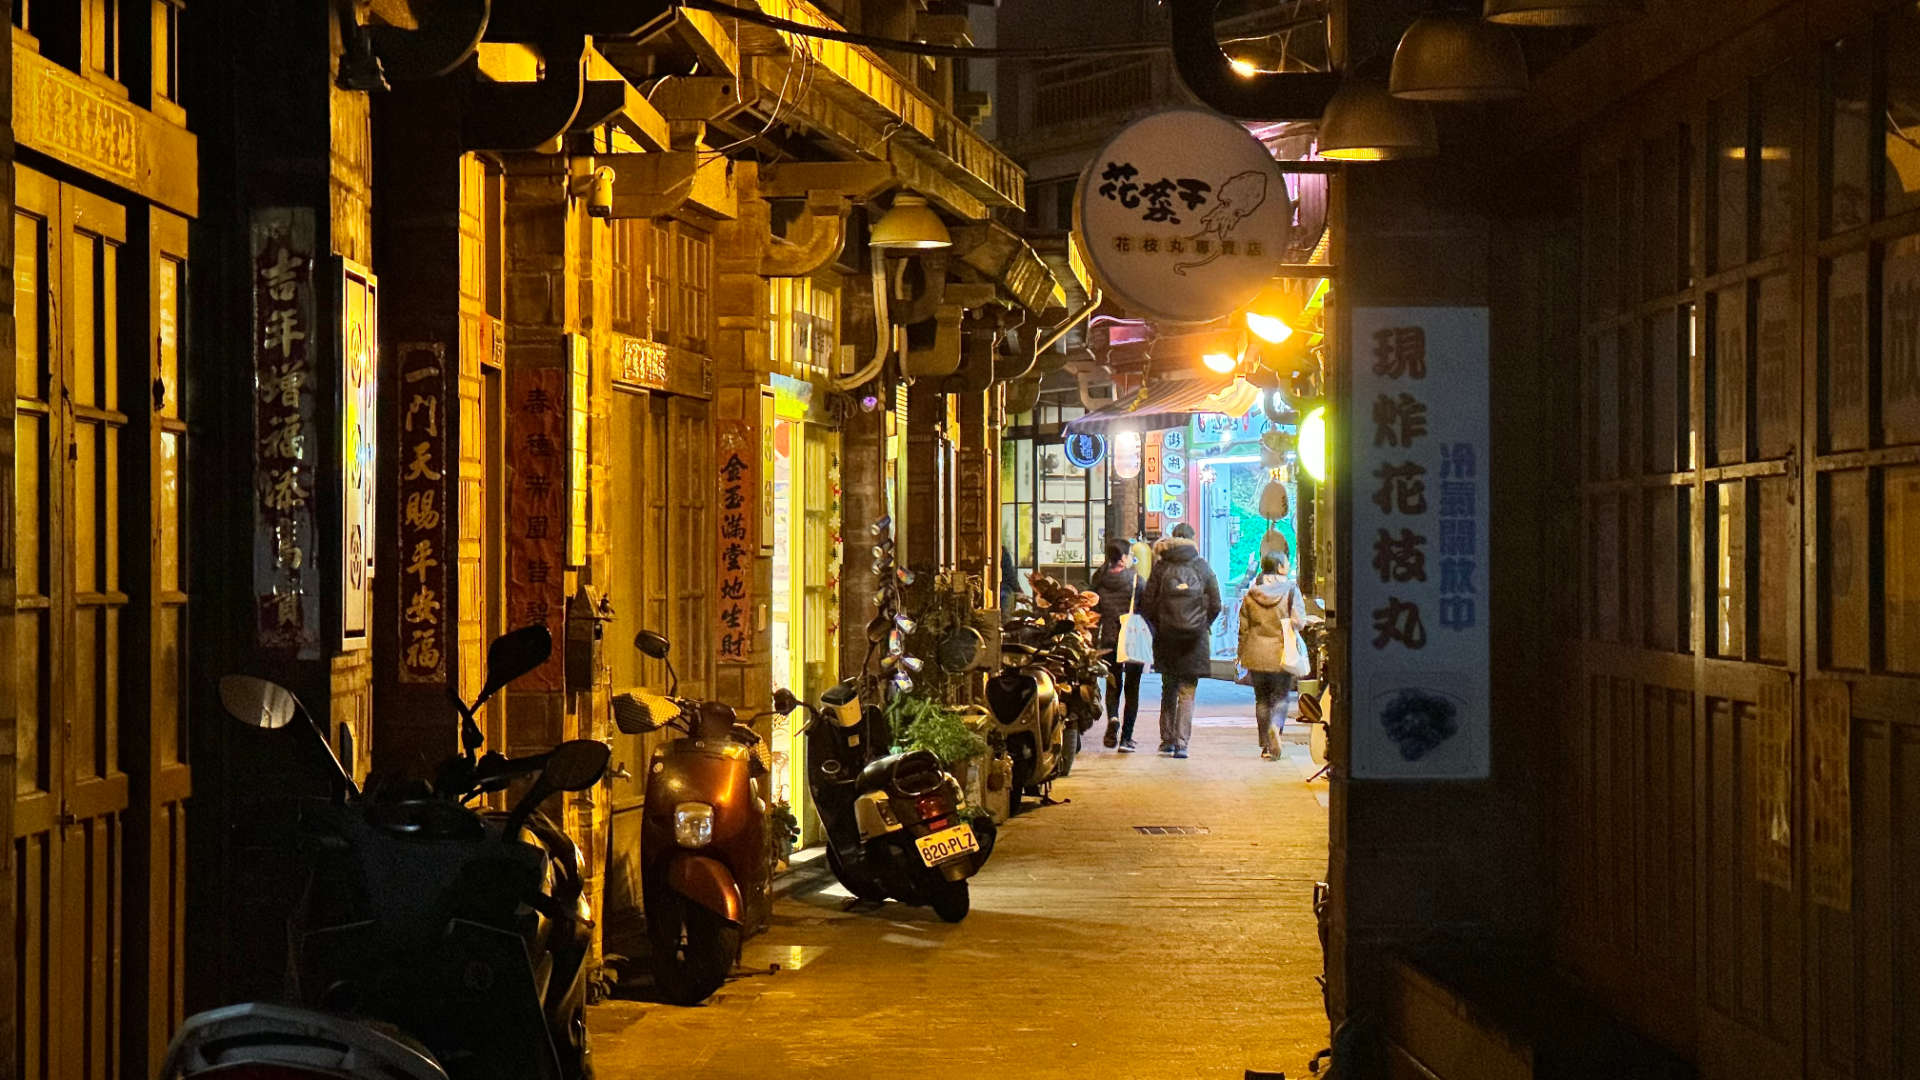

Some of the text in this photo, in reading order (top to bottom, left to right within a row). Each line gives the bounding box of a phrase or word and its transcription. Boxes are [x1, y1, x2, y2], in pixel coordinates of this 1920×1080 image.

[1115, 236, 1263, 257] 花枝丸專賣店
[404, 365, 443, 670] 一門天賜平安福
[720, 453, 748, 657] 金玉滿堂地生財
[1372, 325, 1428, 651] 現炸花枝丸
[1439, 442, 1477, 633] 冷氣開放中
[922, 833, 976, 862] 820-PLZ
